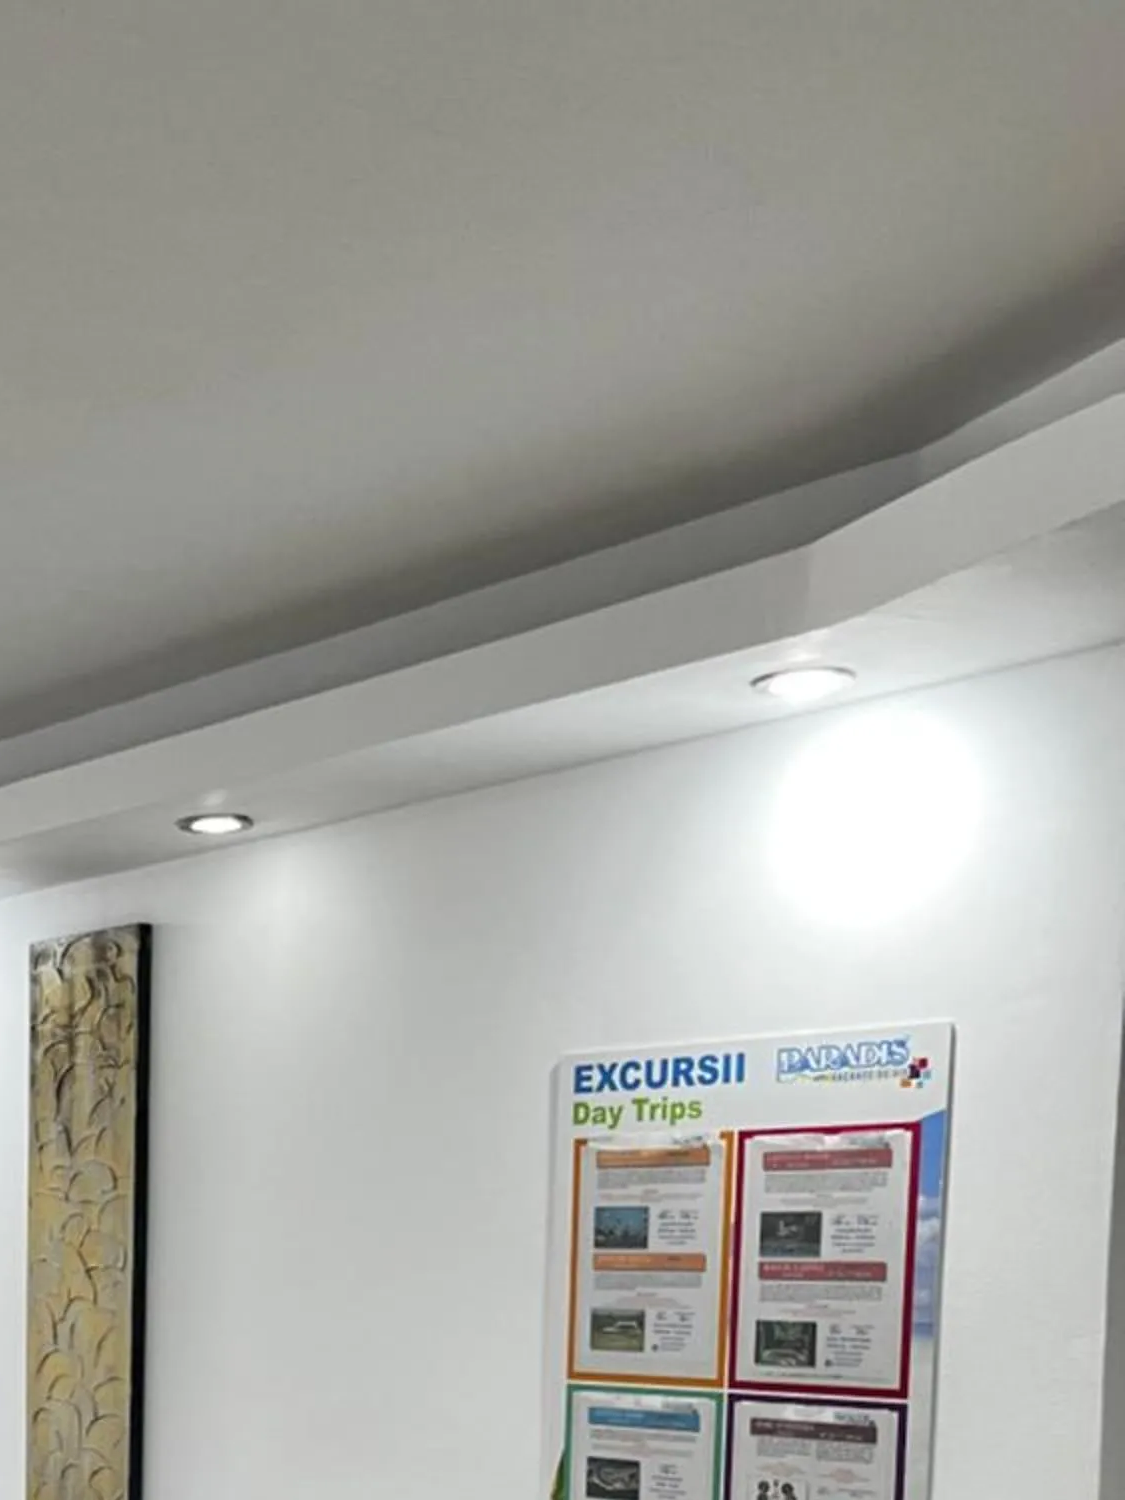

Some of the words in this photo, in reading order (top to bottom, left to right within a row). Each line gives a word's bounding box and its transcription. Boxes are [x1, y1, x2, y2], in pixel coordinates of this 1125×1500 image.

[573, 1052, 746, 1094] EXCURSII
[777, 1037, 910, 1075] PARADIS
[572, 1101, 624, 1130] Day
[631, 1096, 703, 1126] Trips
